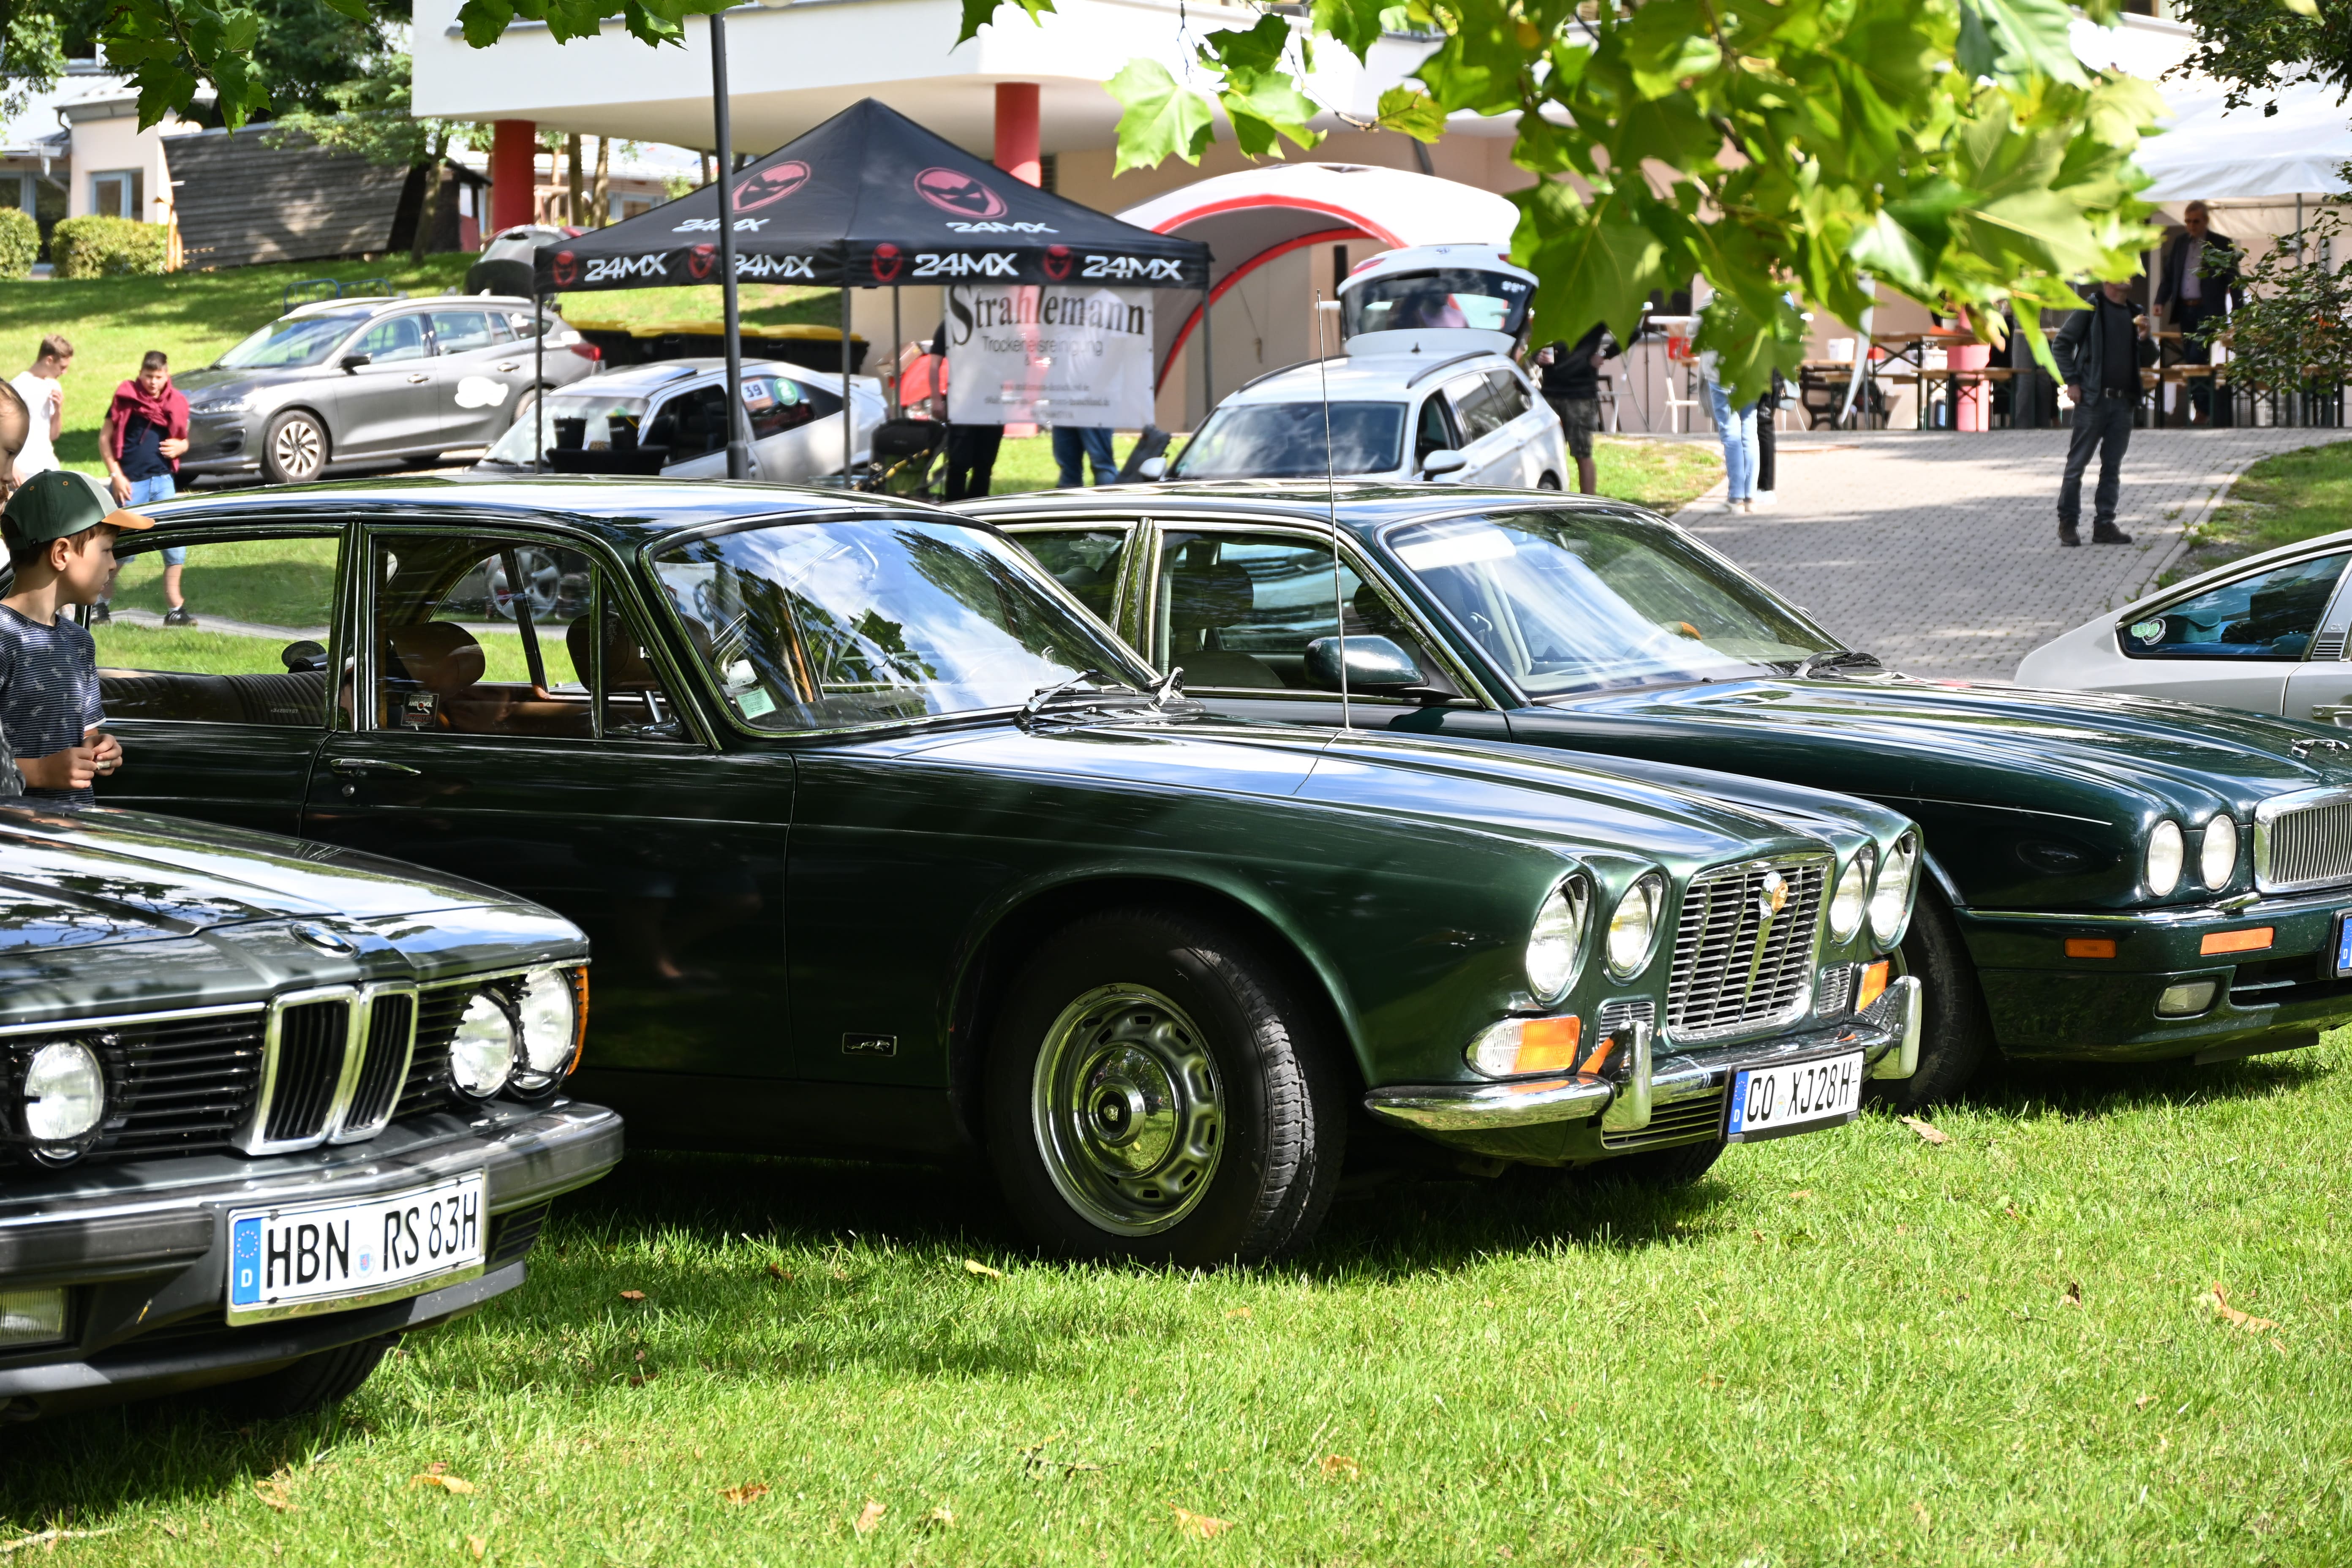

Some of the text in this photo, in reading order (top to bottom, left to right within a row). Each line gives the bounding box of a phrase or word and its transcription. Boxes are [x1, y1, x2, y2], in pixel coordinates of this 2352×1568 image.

[945, 222, 1060, 233] 24MX
[585, 252, 667, 282] 24MX
[912, 253, 1183, 280] 24MX 24MX
[948, 285, 1145, 346] Strahlemann
[744, 384, 762, 398] 39
[2342, 948, 2348, 959] D
[1747, 1075, 1775, 1122] CO
[1733, 1109, 1740, 1122] D
[267, 1191, 477, 1288] HBN RS 83H
[241, 1269, 252, 1288] D
